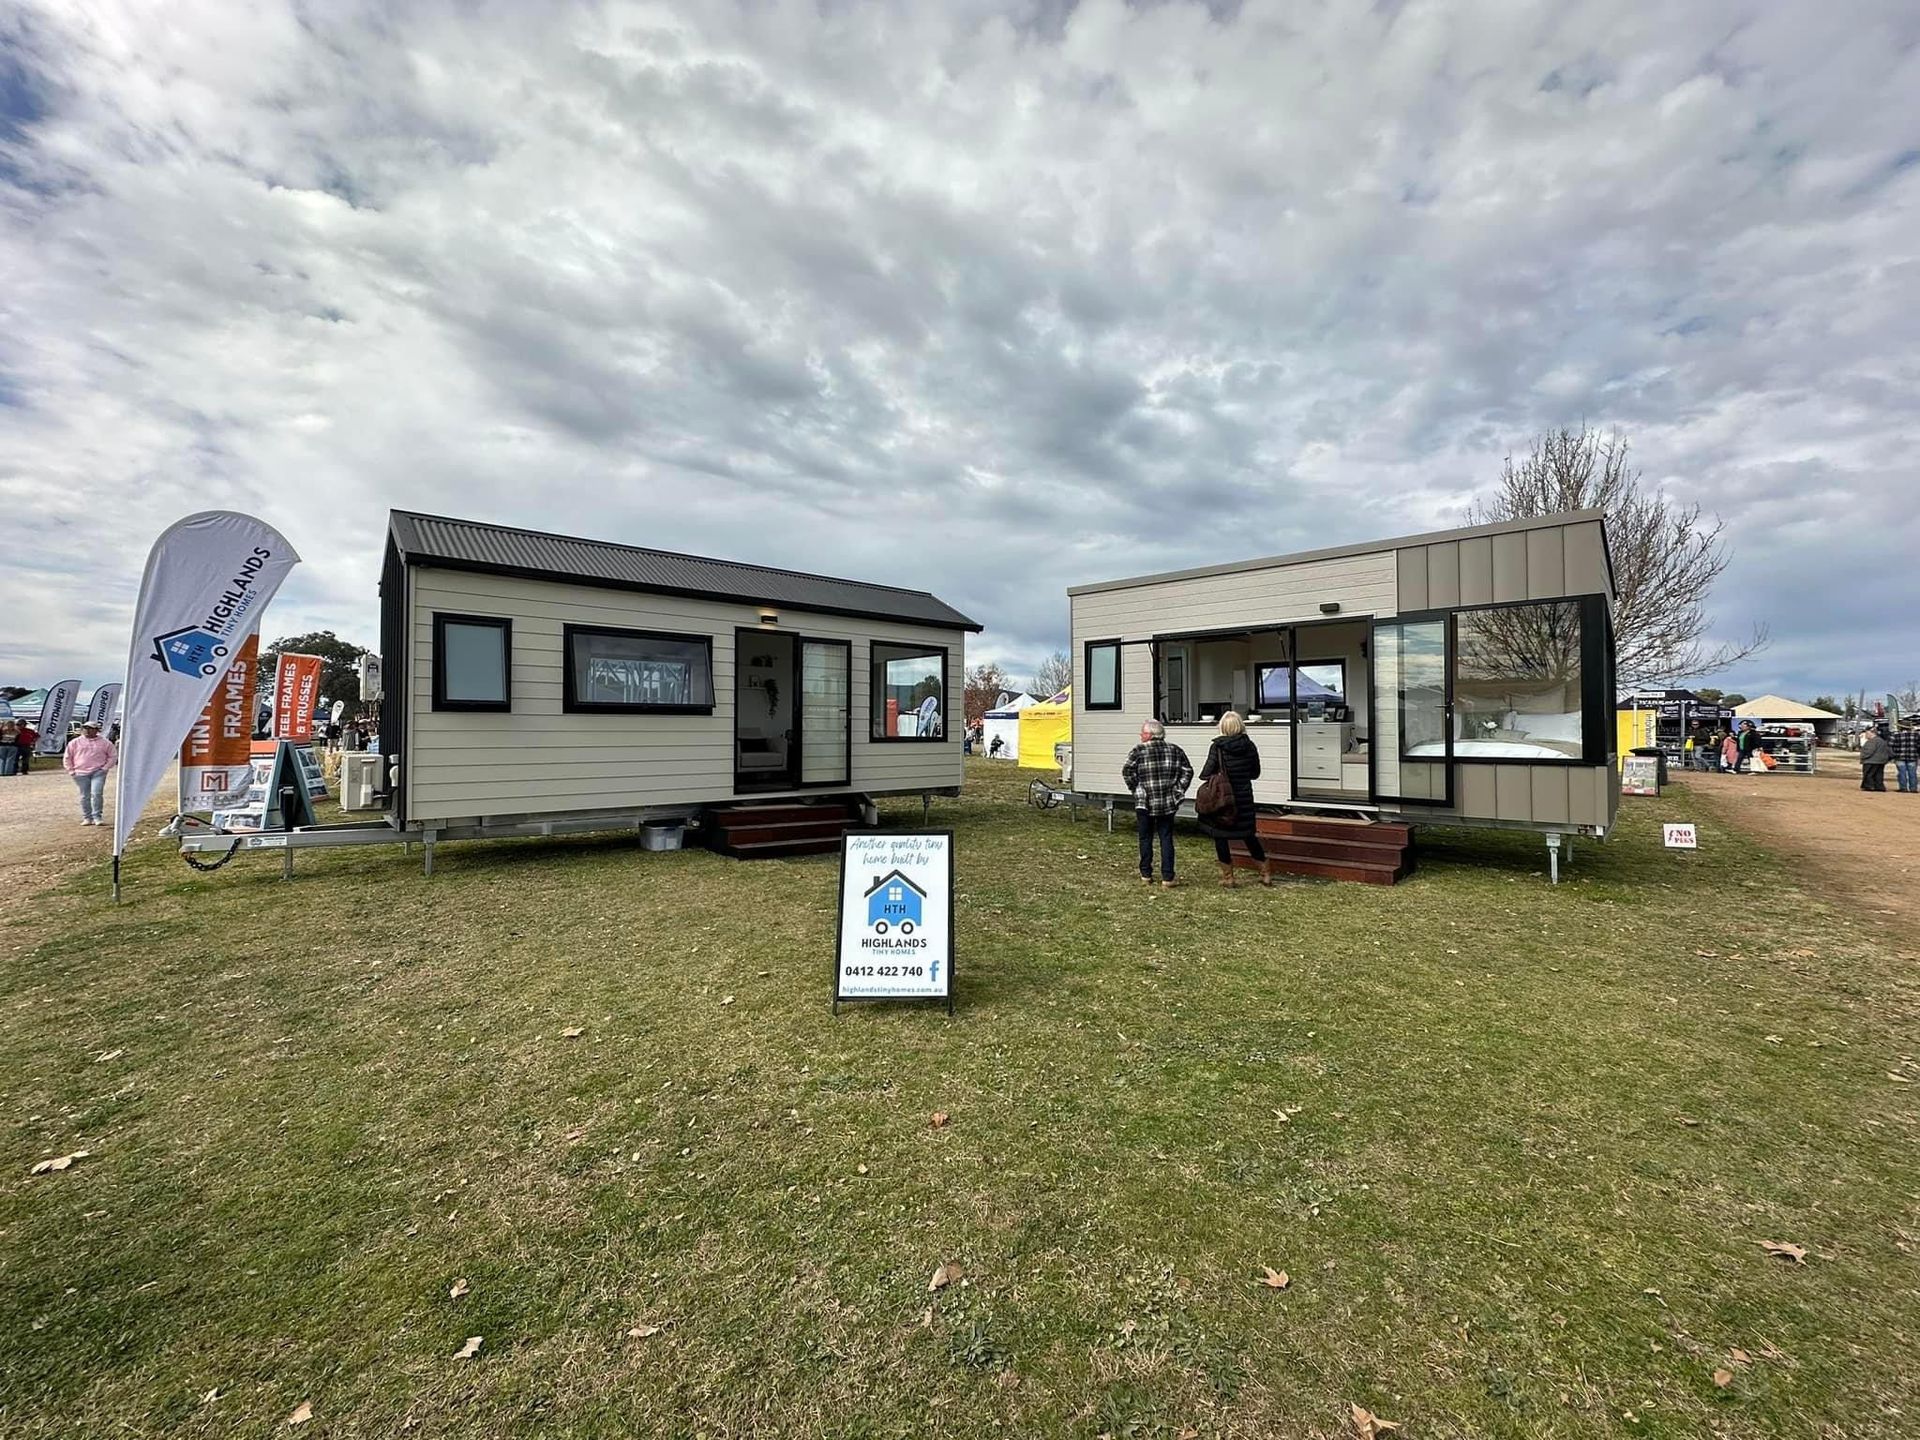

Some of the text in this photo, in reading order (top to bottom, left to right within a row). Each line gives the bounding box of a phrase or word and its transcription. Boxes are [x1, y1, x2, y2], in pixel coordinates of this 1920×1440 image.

[202, 547, 270, 634] HIGHLANDS
[220, 589, 257, 636] TINY HOMES
[188, 645, 206, 663] HTH
[223, 661, 247, 738] FRAMES
[280, 663, 296, 738] TEEL FRAMES
[297, 674, 313, 724] TRUSSES
[192, 714, 211, 757] TINY
[850, 838, 943, 852] Another quality tiny
[863, 852, 929, 865] home built by
[884, 904, 906, 914] HTH
[862, 938, 927, 948] HIGHLANDS
[845, 966, 923, 976] 0412 422 740
[842, 985, 943, 994] highlandstinyhomes.com.au
